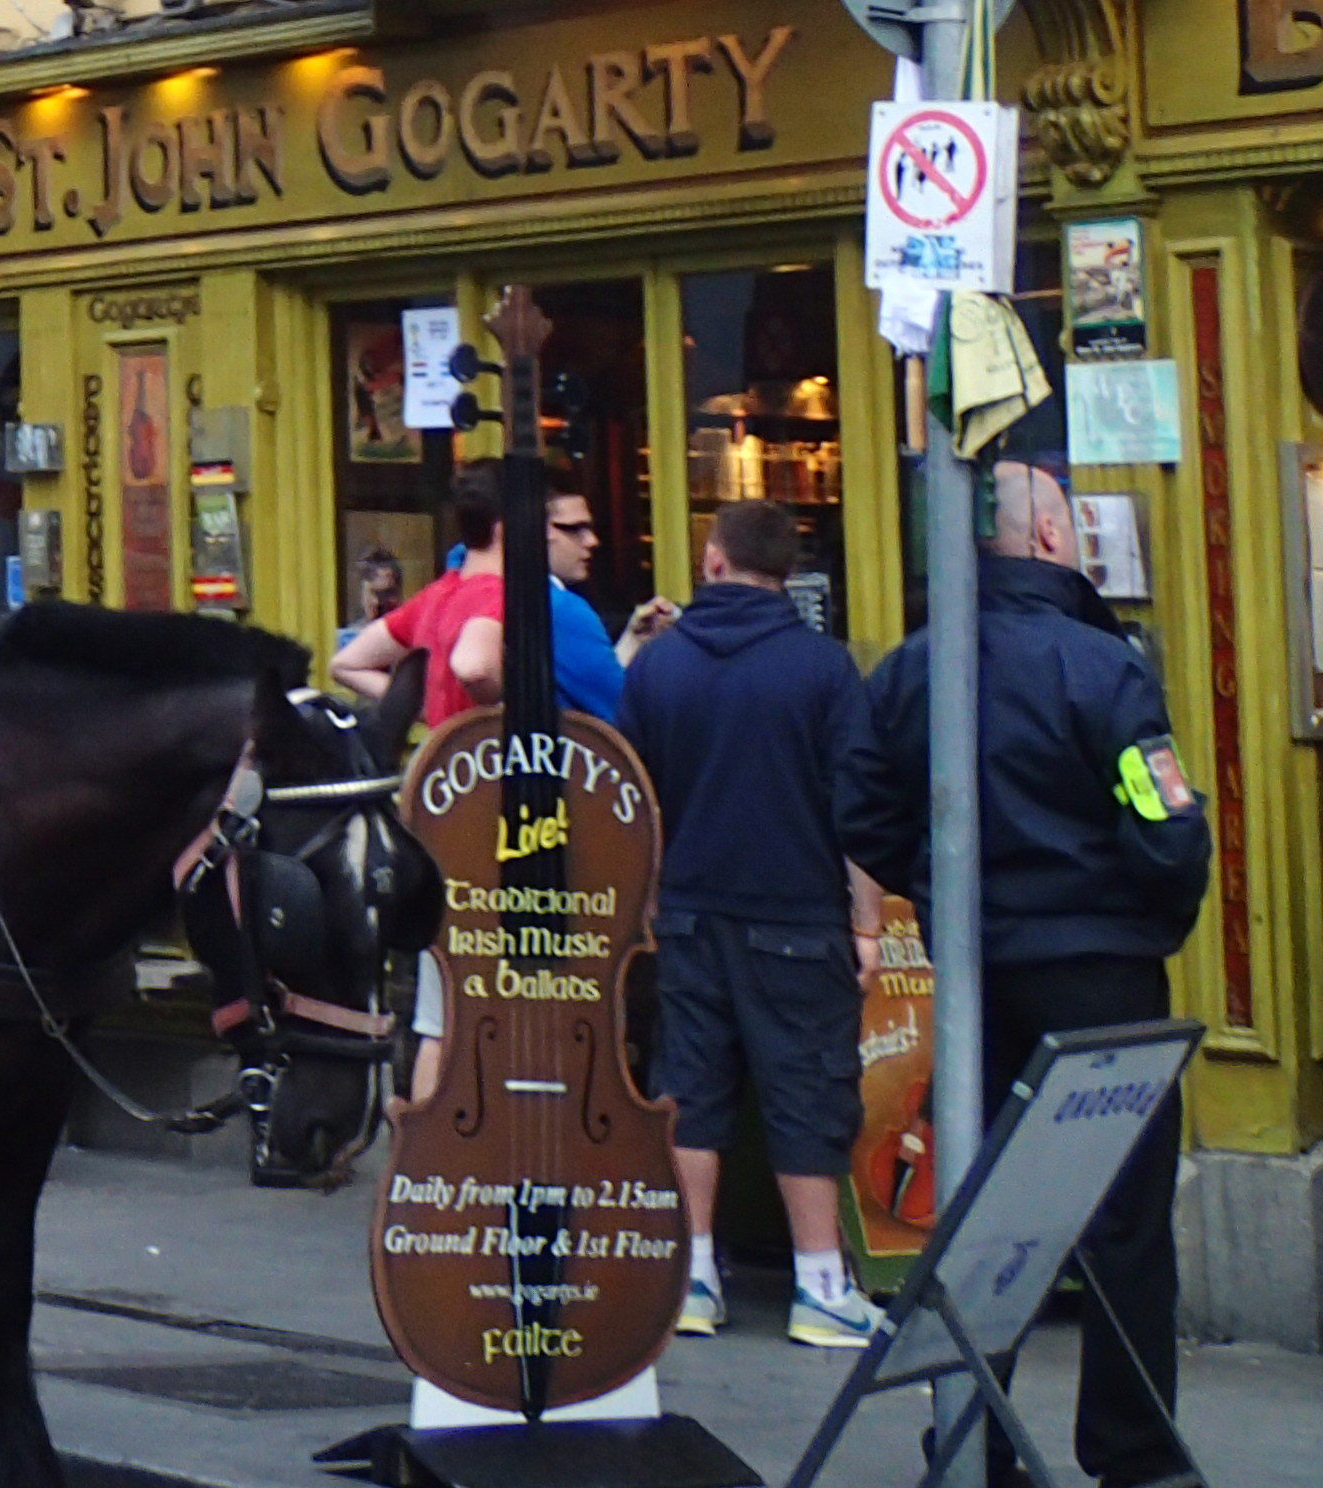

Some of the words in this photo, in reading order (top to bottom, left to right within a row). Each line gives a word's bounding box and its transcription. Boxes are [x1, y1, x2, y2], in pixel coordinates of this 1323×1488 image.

[83, 102, 284, 240] JOHN
[318, 24, 803, 197] GOGARTY
[422, 732, 641, 825] GOGARTY'S
[495, 796, 570, 862] Live!
[389, 1174, 455, 1211] Daily
[455, 1177, 516, 1211] from
[519, 1178, 568, 1213] 1pm
[571, 1181, 595, 1208] to
[384, 1225, 476, 1255] Ground
[481, 1227, 547, 1257] Floor
[550, 1228, 572, 1257] &
[614, 1230, 678, 1260] Floor
